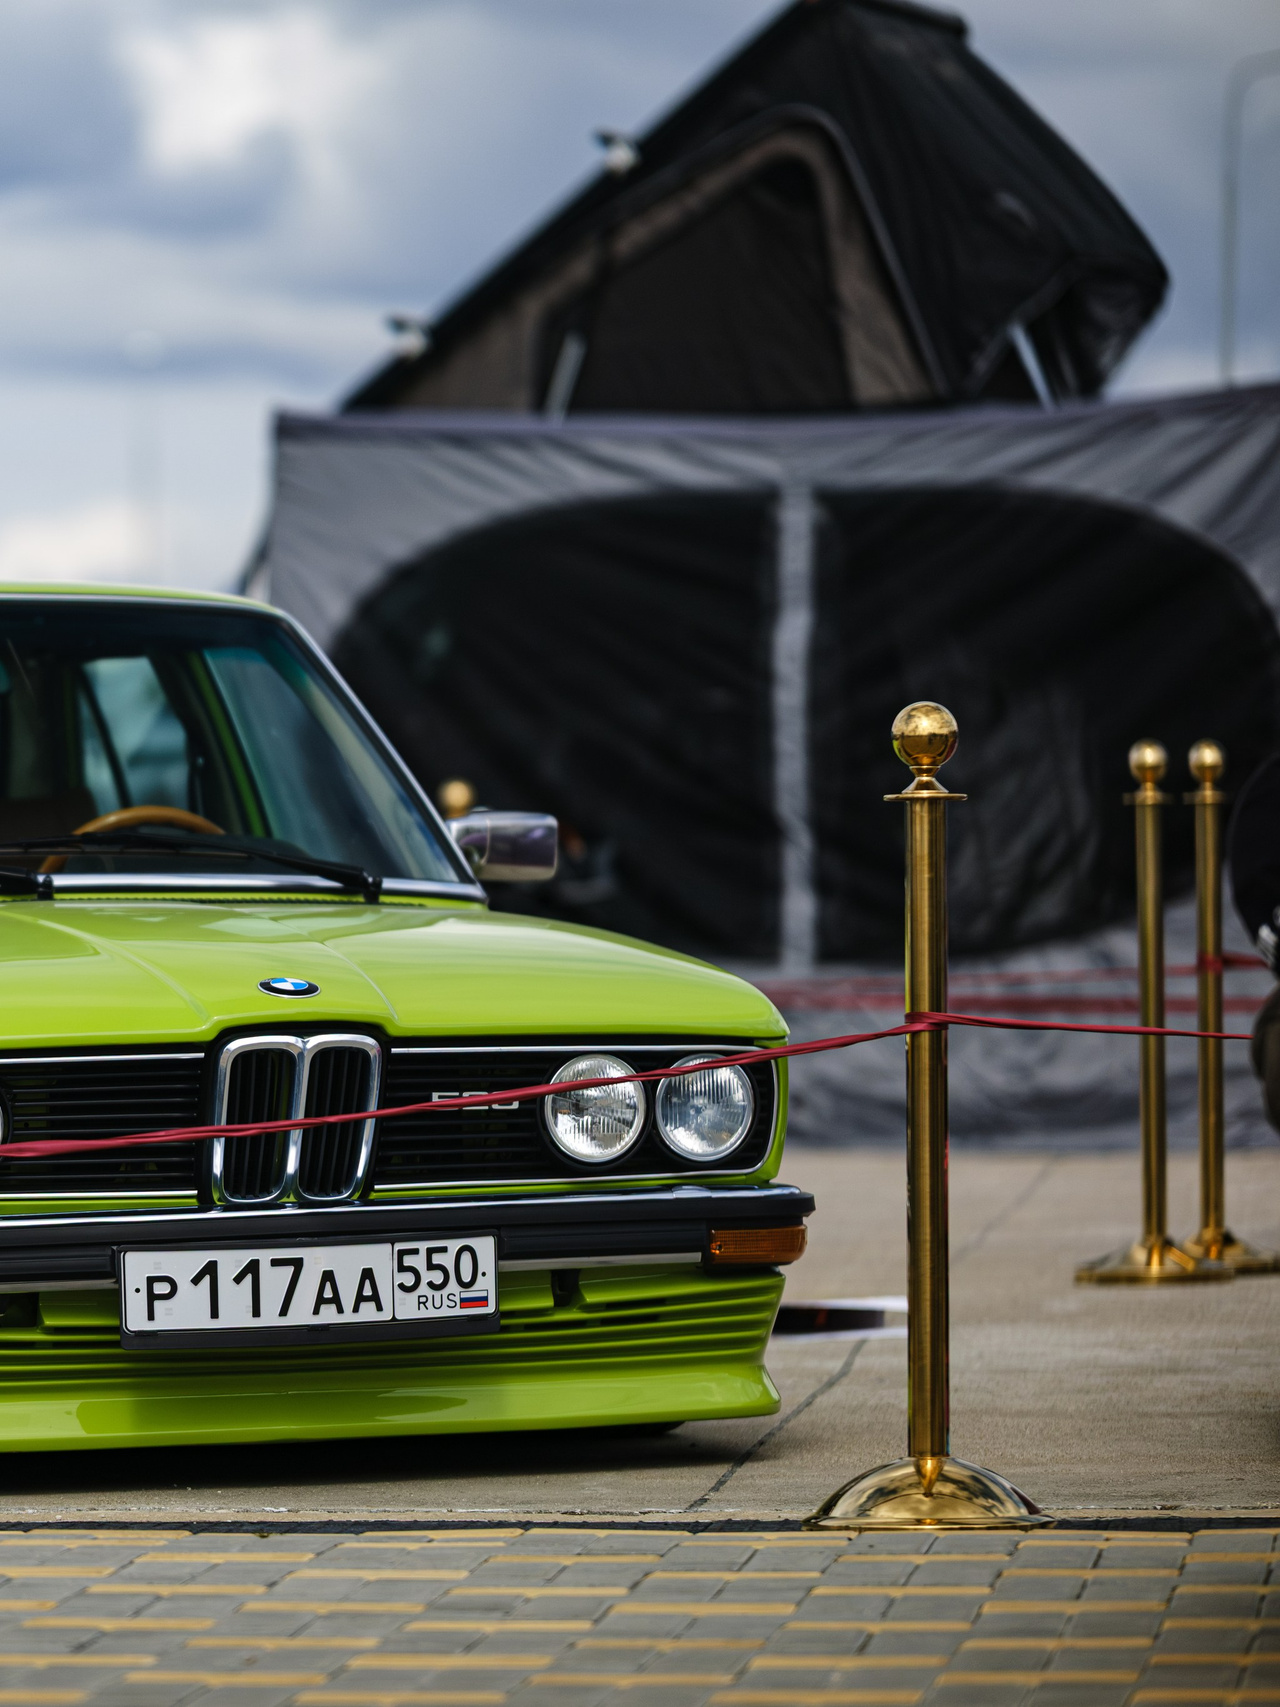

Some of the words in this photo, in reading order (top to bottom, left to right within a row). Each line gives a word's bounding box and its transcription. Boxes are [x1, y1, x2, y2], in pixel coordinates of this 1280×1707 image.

[146, 1257, 384, 1322] P117AA
[396, 1244, 479, 1293] 550
[417, 1292, 457, 1311] RUS
